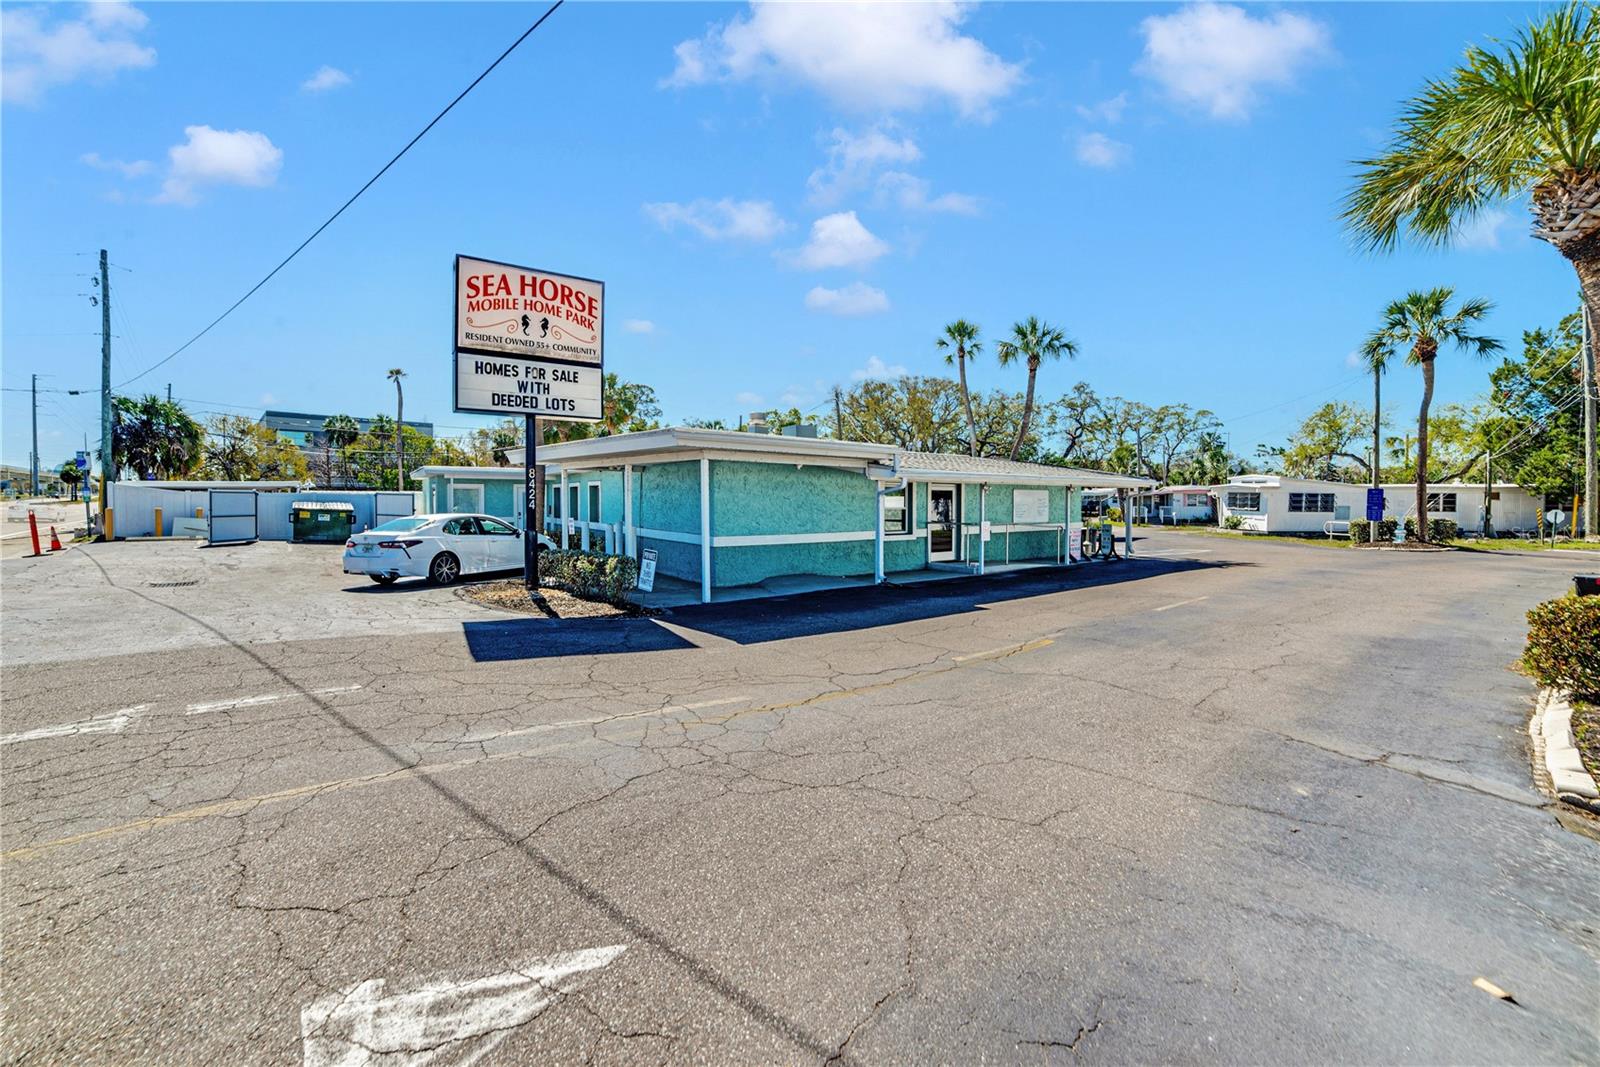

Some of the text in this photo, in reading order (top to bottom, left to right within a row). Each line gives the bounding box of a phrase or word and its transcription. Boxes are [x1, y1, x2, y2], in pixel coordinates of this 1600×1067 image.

[466, 273, 598, 320] SEA HORSE
[467, 298, 595, 332] MOBILE HOME PARK
[465, 332, 597, 356] RESIDENT OWNED 55+ COMMUNITY
[475, 361, 579, 383] HOMES FOR SALE
[517, 380, 550, 395] WITH
[492, 393, 575, 411] DEEDED LOTS
[528, 468, 536, 510] 8424
